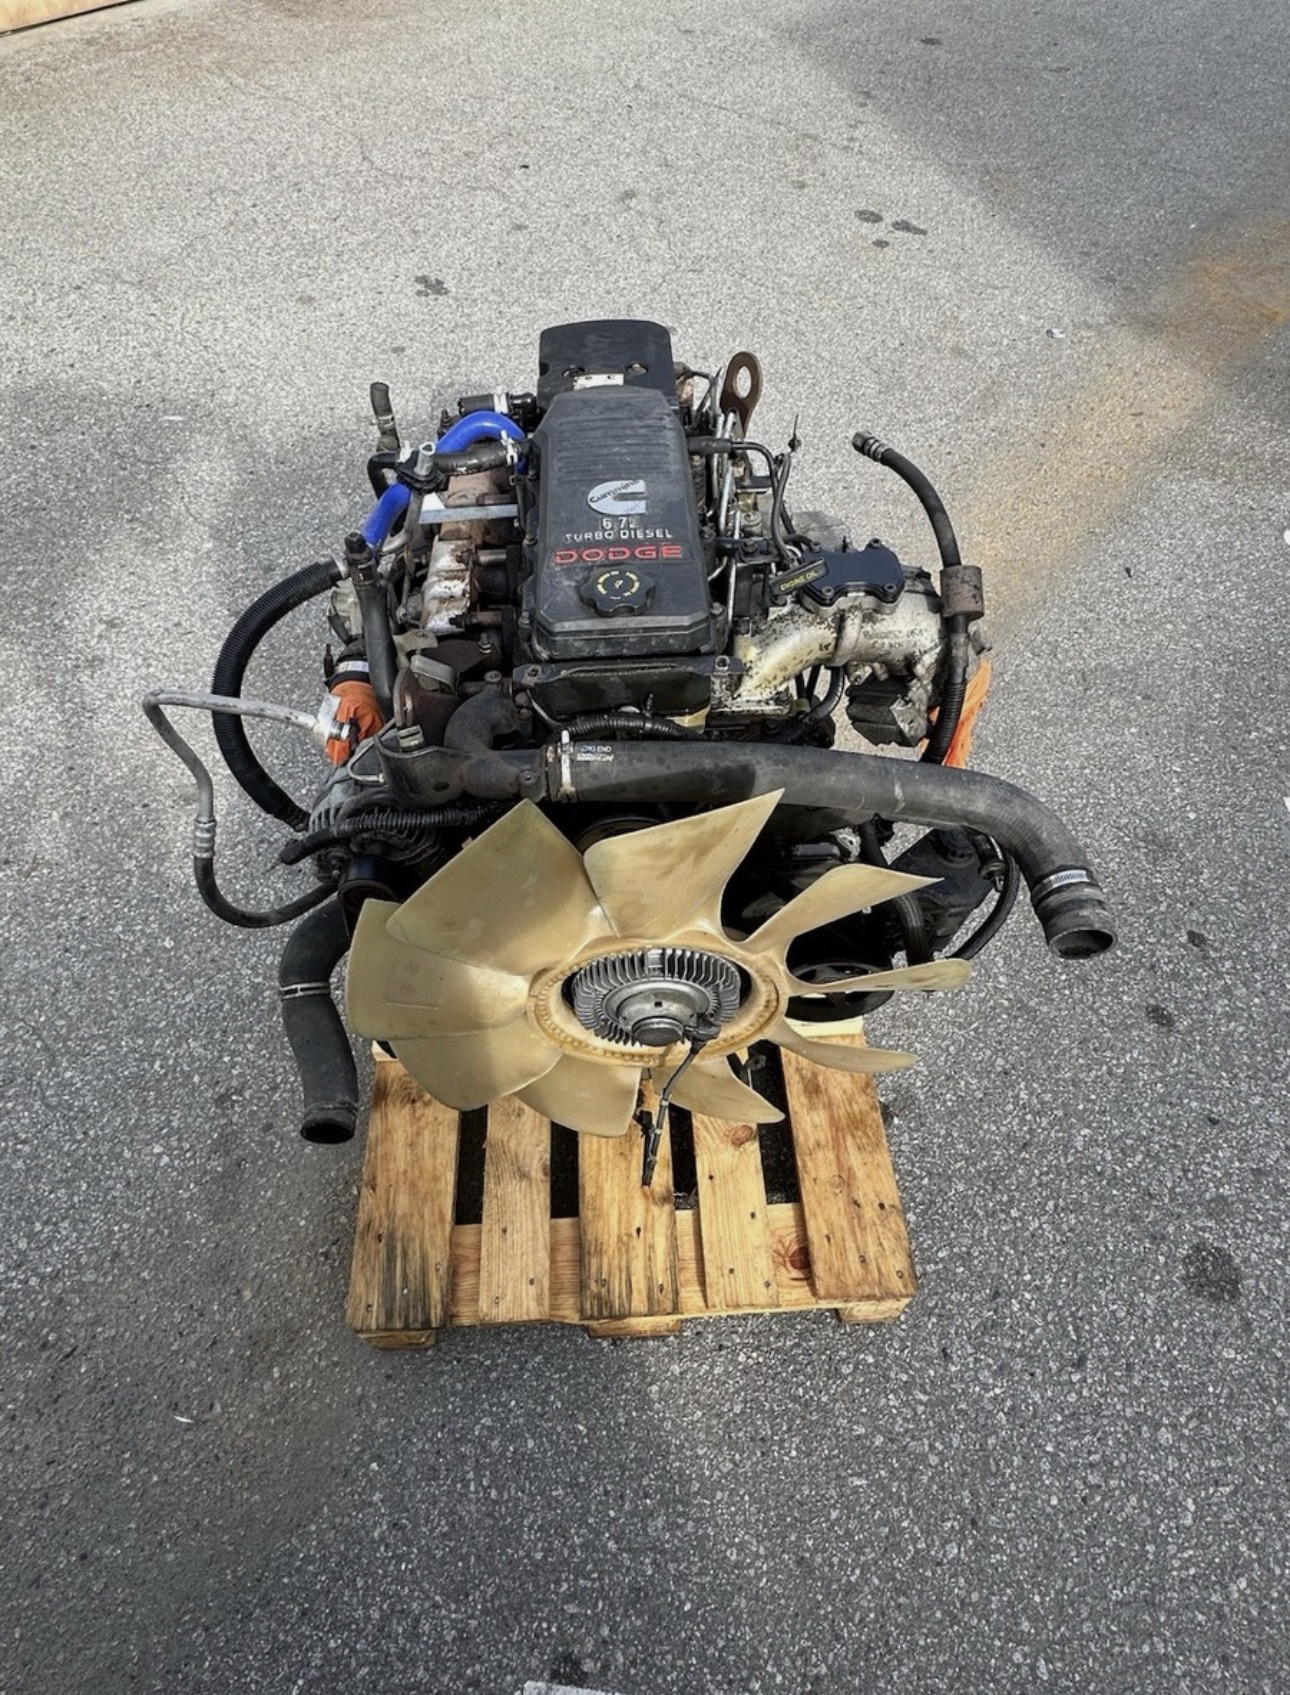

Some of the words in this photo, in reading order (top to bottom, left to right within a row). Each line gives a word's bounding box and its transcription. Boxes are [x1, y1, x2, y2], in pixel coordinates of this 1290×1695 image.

[589, 480, 640, 503] Cummins
[565, 530, 614, 543] TURBO
[620, 528, 672, 539] DIESEL
[555, 545, 683, 564] DODGE
